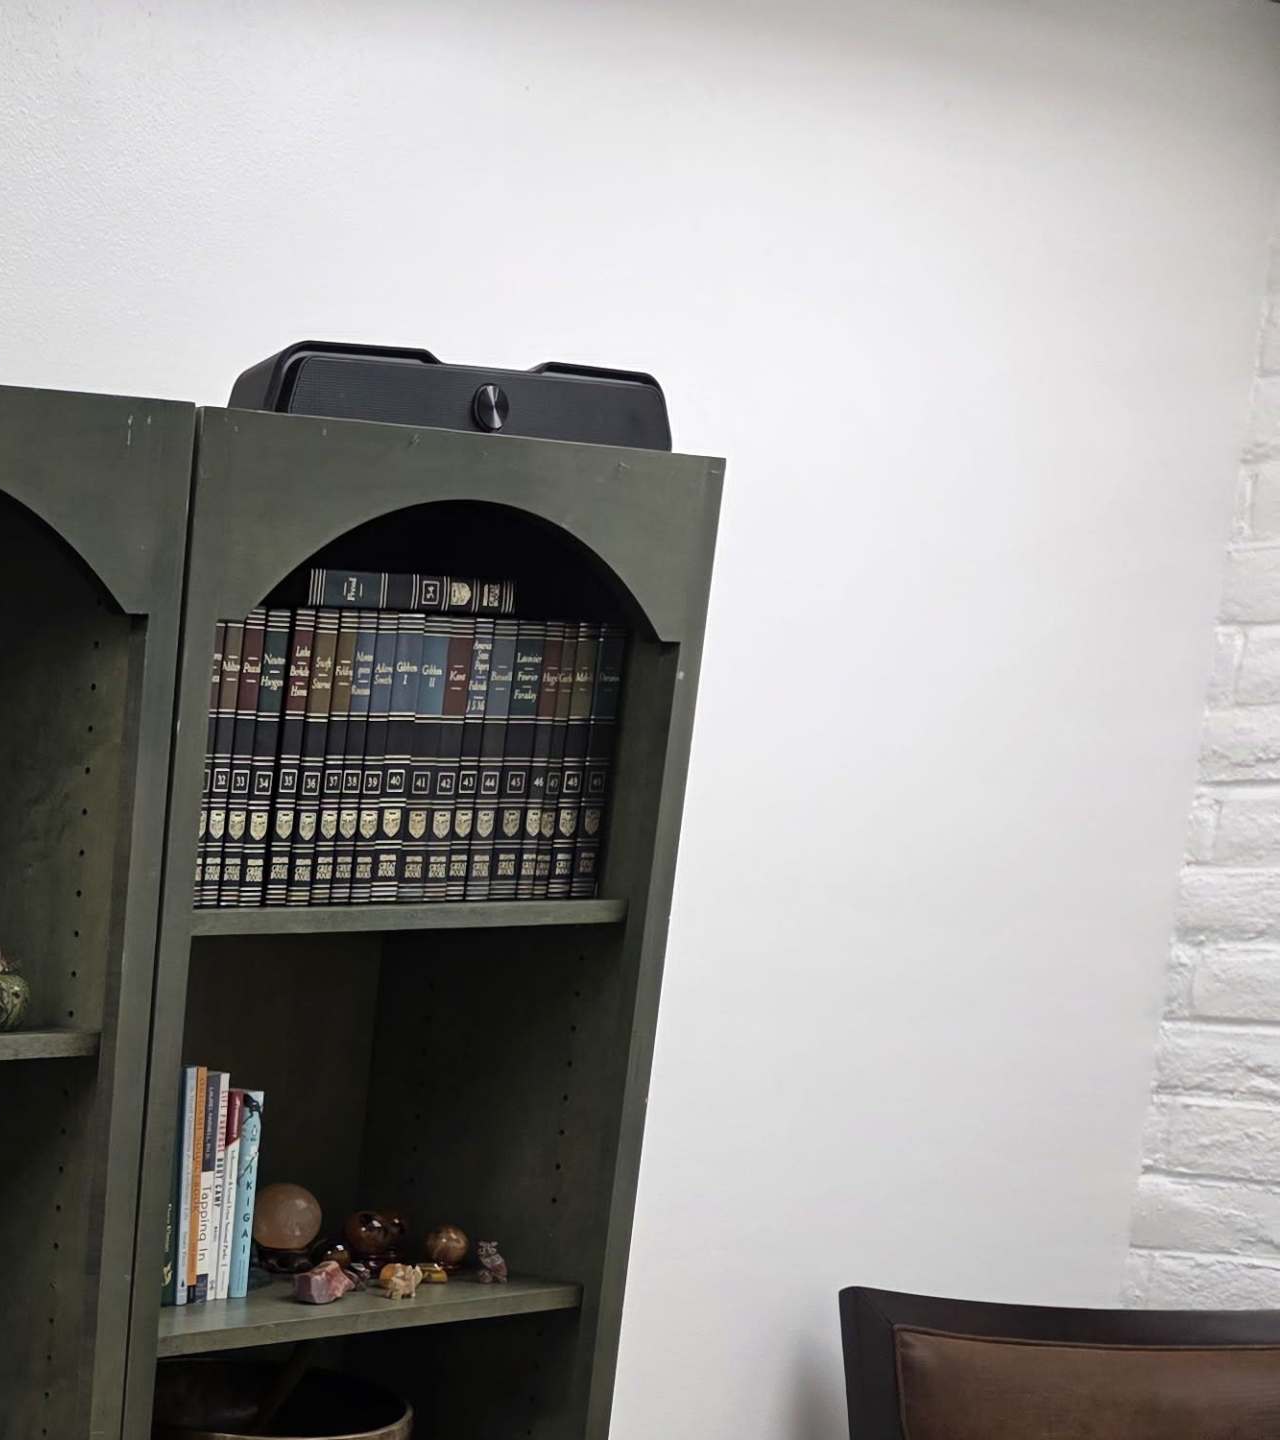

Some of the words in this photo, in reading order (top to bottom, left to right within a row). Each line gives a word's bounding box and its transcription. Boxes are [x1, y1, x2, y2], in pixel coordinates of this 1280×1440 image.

[449, 669, 467, 682] Kant
[199, 1185, 212, 1241] Tapping
[198, 1248, 209, 1262] In
